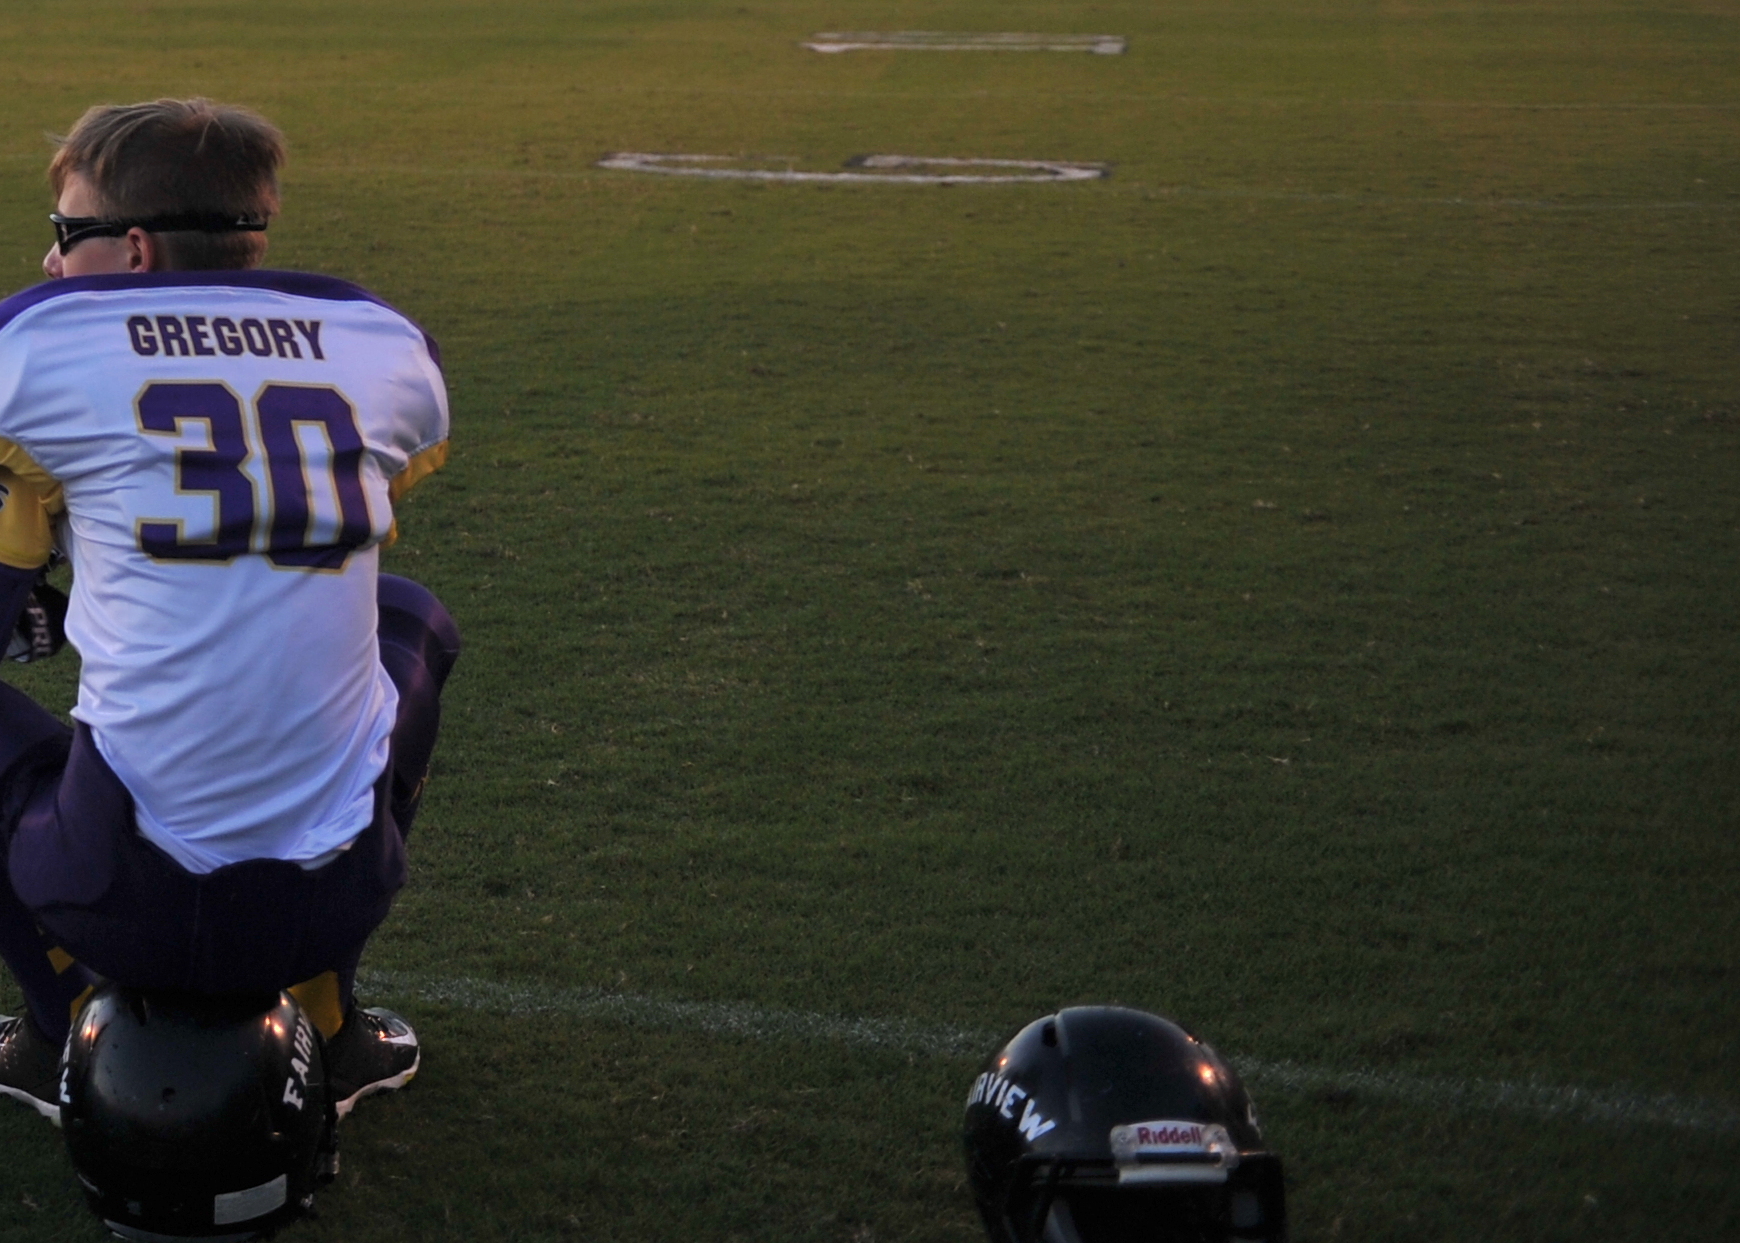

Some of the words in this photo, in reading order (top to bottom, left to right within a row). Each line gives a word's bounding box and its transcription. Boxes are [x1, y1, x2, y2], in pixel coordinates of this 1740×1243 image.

[126, 314, 323, 361] GREGORY
[133, 379, 373, 574] 30
[1136, 1125, 1202, 1147] Riddell
